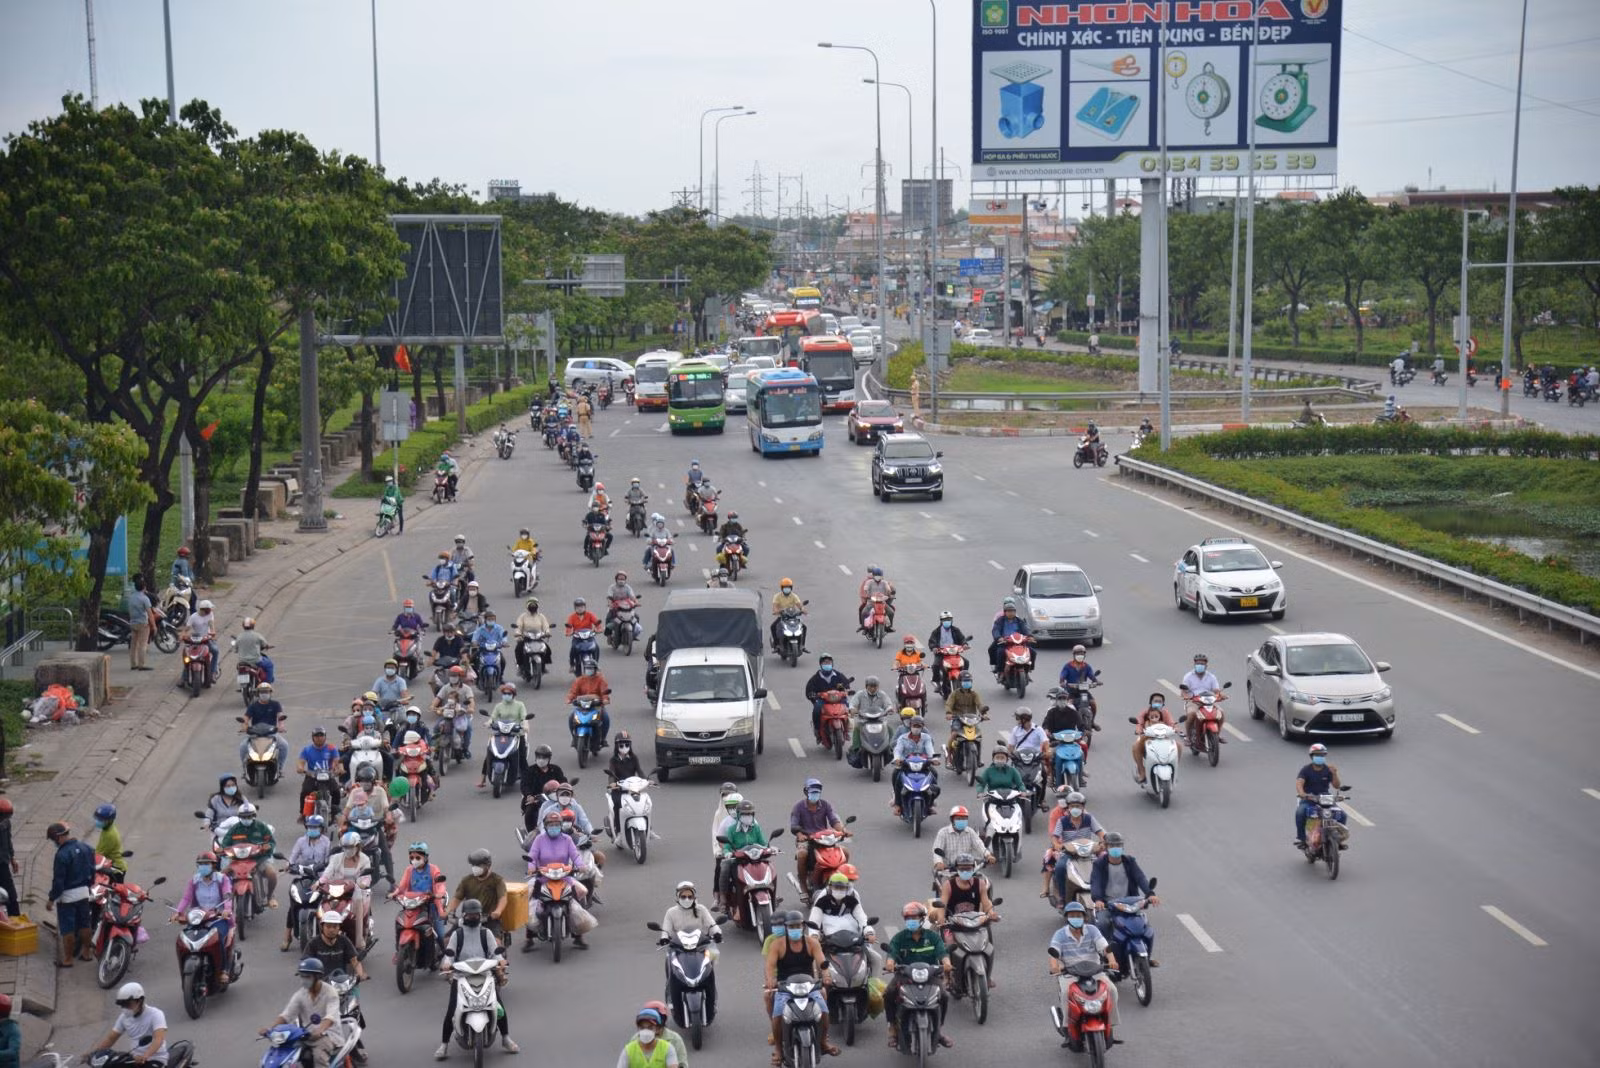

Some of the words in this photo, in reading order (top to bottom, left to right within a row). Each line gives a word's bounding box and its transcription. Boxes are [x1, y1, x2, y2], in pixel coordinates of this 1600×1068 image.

[1017, 28, 1067, 48] CHÍNH
[1071, 27, 1103, 46] XÁC
[1116, 27, 1153, 46] TIỆN
[1158, 26, 1206, 46] DỤNG
[1258, 25, 1292, 43] ĐẸP
[1209, 154, 1240, 171] 39
[1286, 152, 1317, 170] 39
